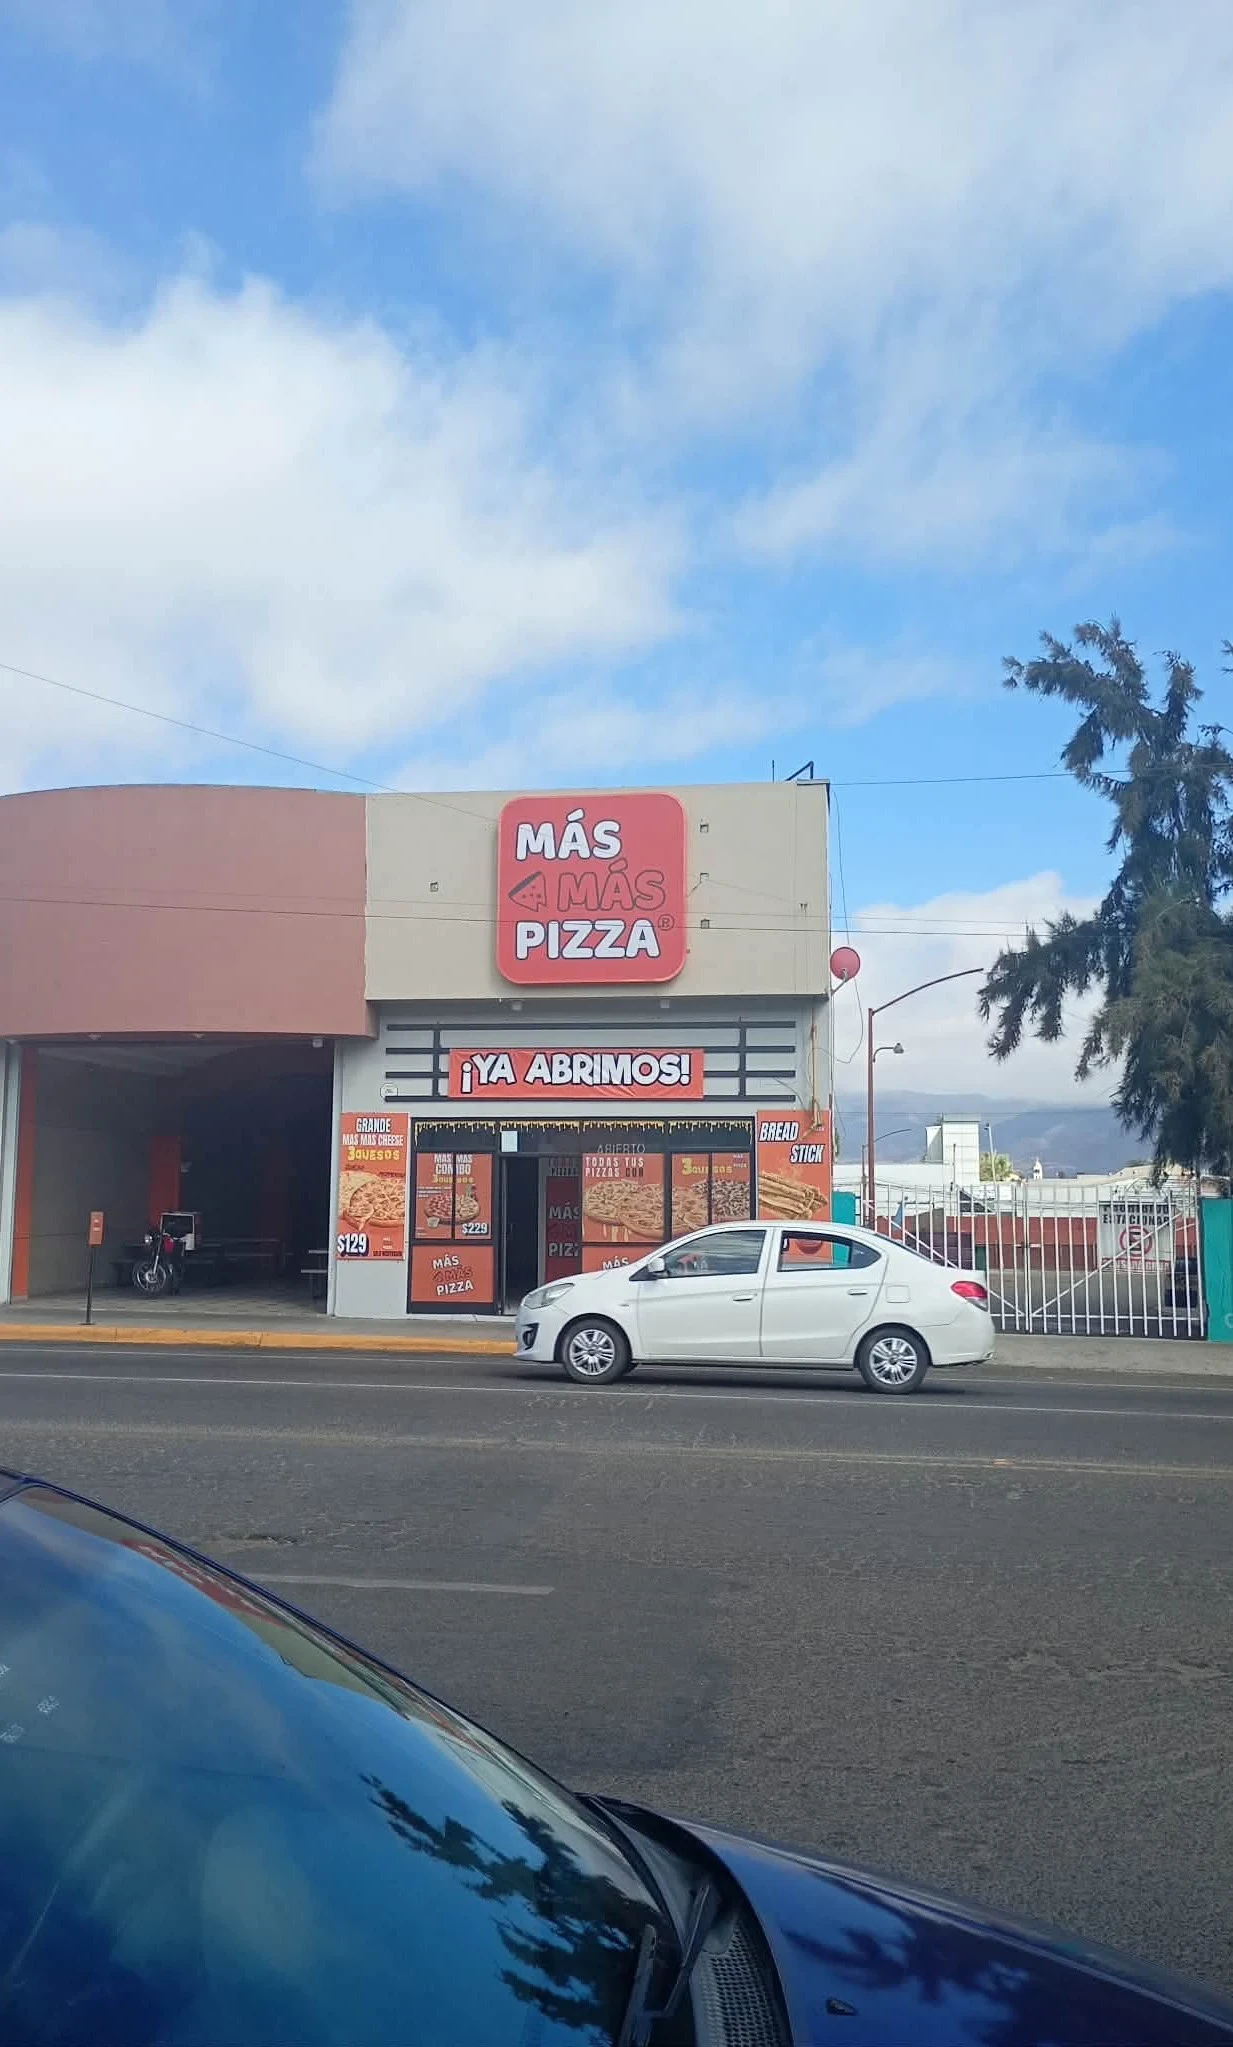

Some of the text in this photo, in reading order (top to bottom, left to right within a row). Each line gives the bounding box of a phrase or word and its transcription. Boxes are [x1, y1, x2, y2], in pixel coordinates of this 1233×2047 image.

[516, 808, 622, 861] MÁS
[557, 858, 666, 912] MÁS
[516, 918, 661, 960] PIZZA
[460, 1052, 692, 1094] ¡YA ABRIMOS!
[356, 1117, 391, 1133] GRANDE
[759, 1121, 799, 1142] BREAD
[378, 1134, 404, 1146] CHEESE
[585, 1157, 619, 1168] TODAS
[625, 1157, 645, 1167] TUS
[790, 1144, 825, 1164] STICK
[585, 1167, 620, 1178] PIZZAS
[462, 1222, 488, 1235] $229
[337, 1232, 368, 1256] $129
[432, 1252, 459, 1270] MÁS
[436, 1279, 474, 1296] PIZZA
